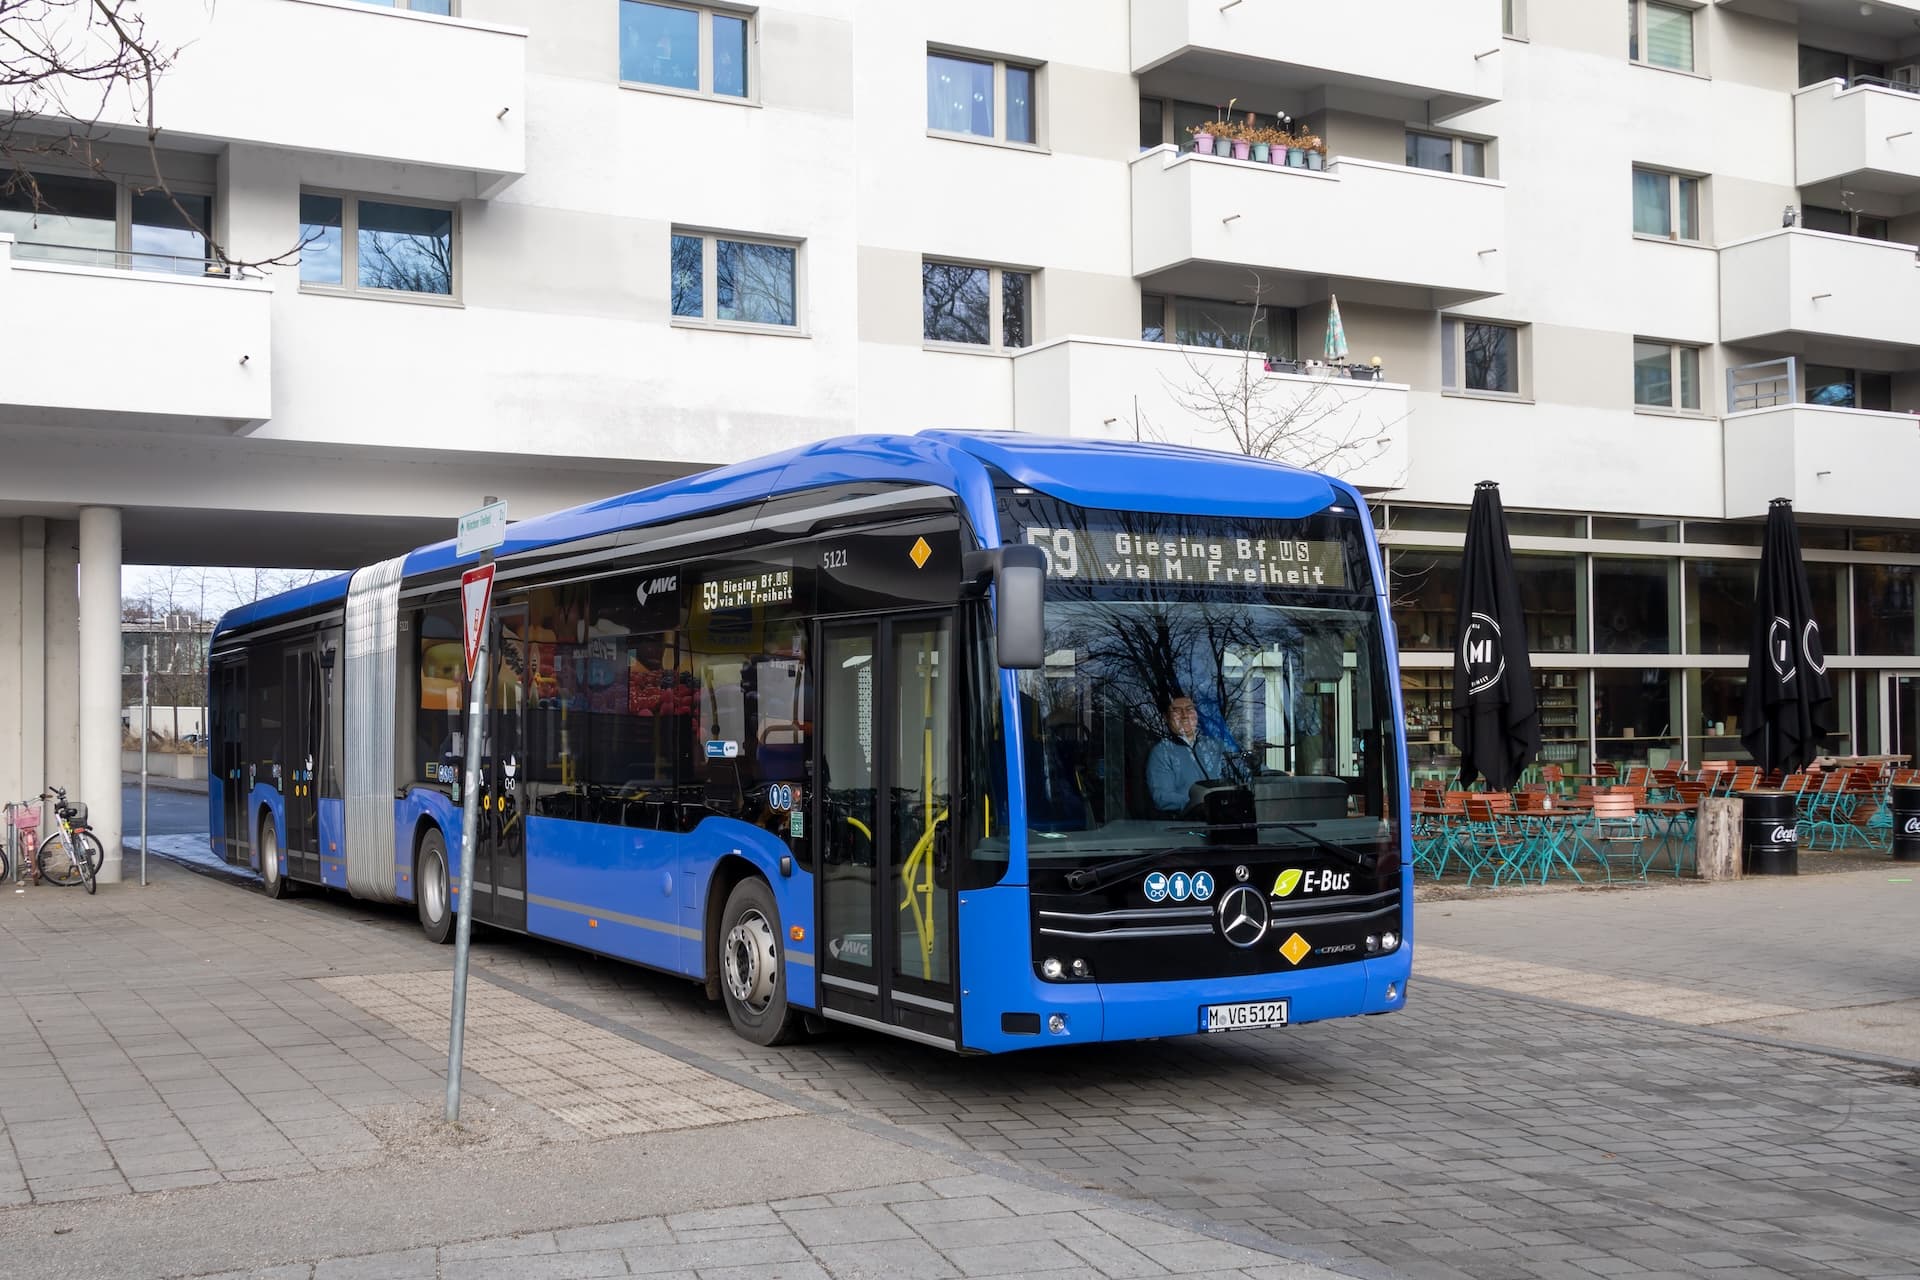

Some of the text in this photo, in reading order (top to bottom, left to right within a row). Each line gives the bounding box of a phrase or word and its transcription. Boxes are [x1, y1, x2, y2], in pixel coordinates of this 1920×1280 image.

[1026, 527, 1078, 578] 59
[1115, 533, 1222, 560] Giesing
[823, 549, 848, 570] 5121
[1106, 558, 1325, 585] via M. Freiheit
[648, 575, 677, 594] MVG
[703, 581, 718, 610] 59
[723, 579, 757, 593] Giesing
[719, 595, 734, 607] via
[751, 586, 792, 603] Freiheit
[1303, 869, 1351, 893] E-Bus
[840, 940, 868, 956] MVG
[1209, 1007, 1218, 1026] M
[1249, 1004, 1285, 1023] 5121
